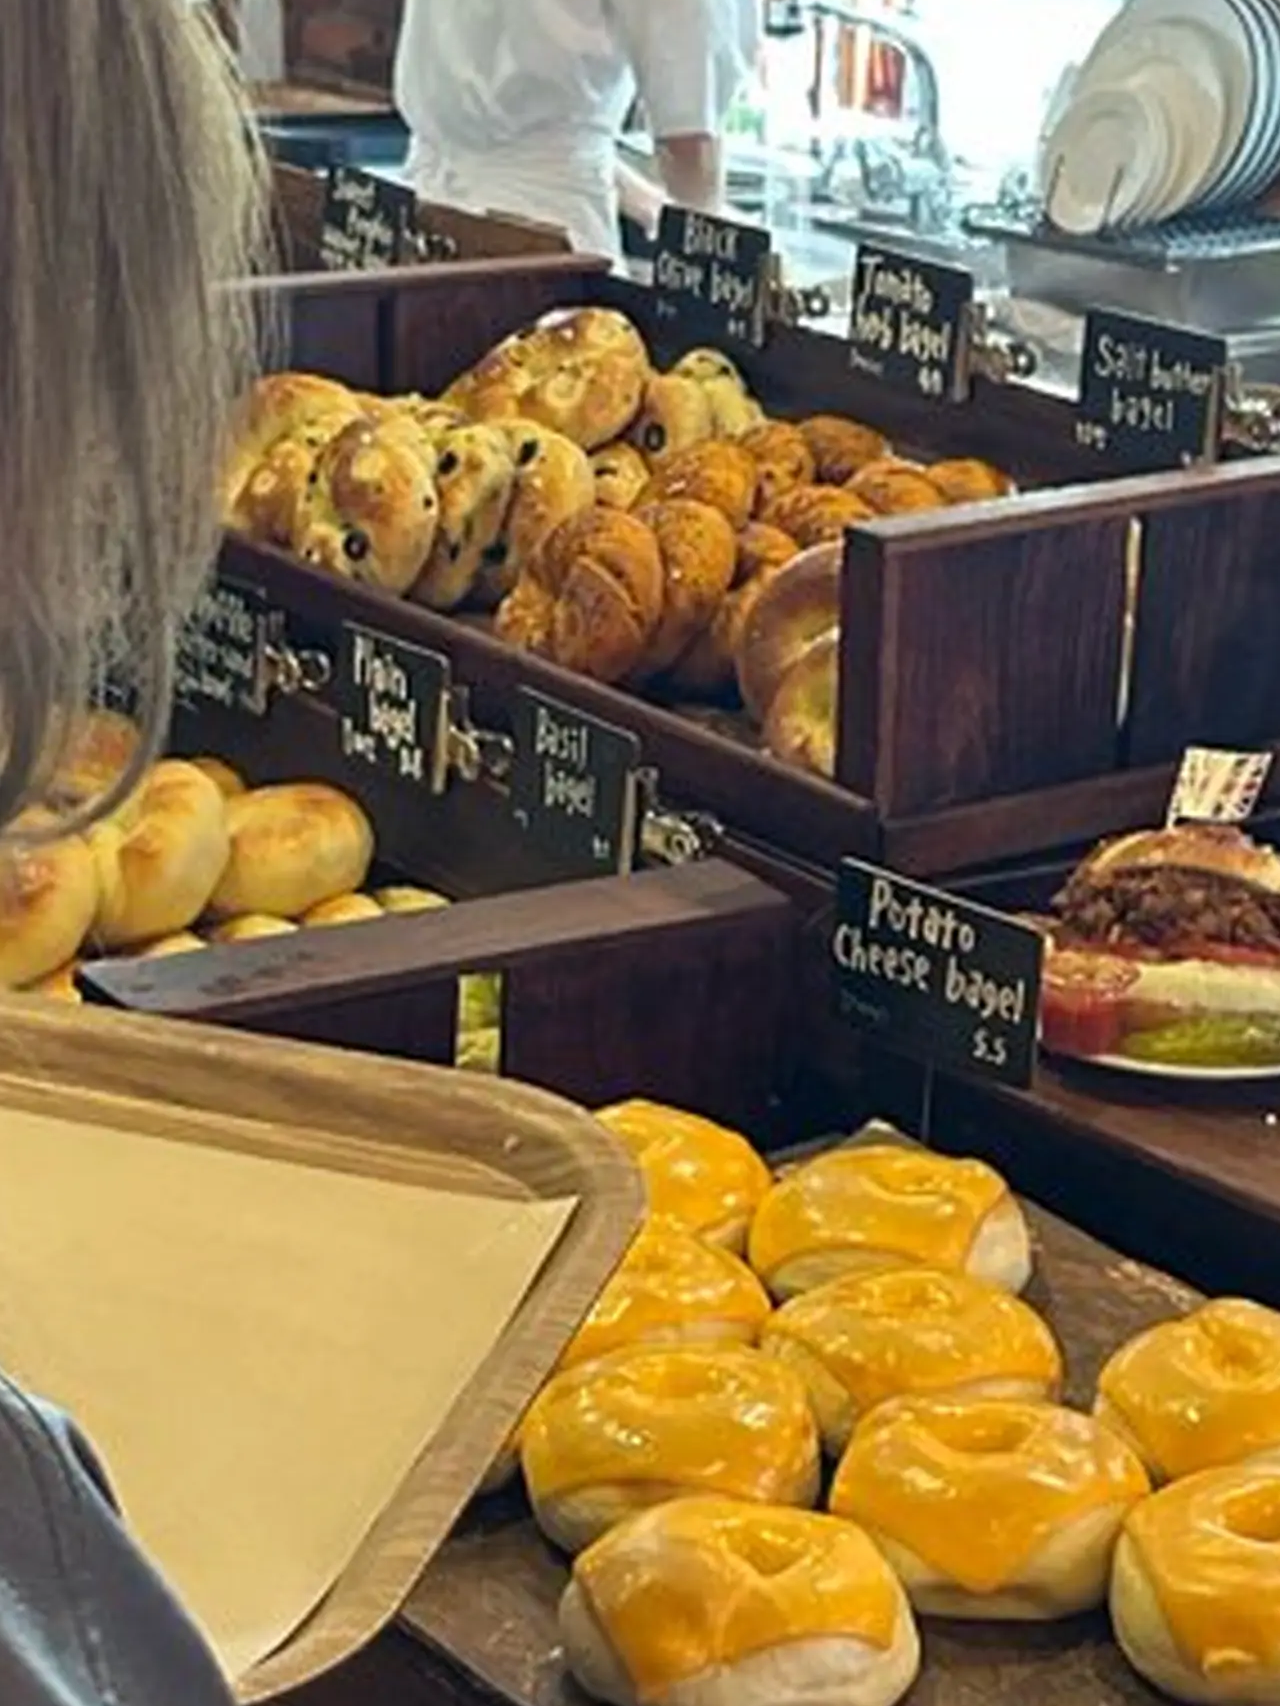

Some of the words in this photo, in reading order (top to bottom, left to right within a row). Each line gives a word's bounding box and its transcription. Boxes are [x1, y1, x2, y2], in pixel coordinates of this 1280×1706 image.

[869, 878, 976, 953] Potato
[833, 923, 931, 993] Cheese
[945, 956, 1025, 1024] bagel
